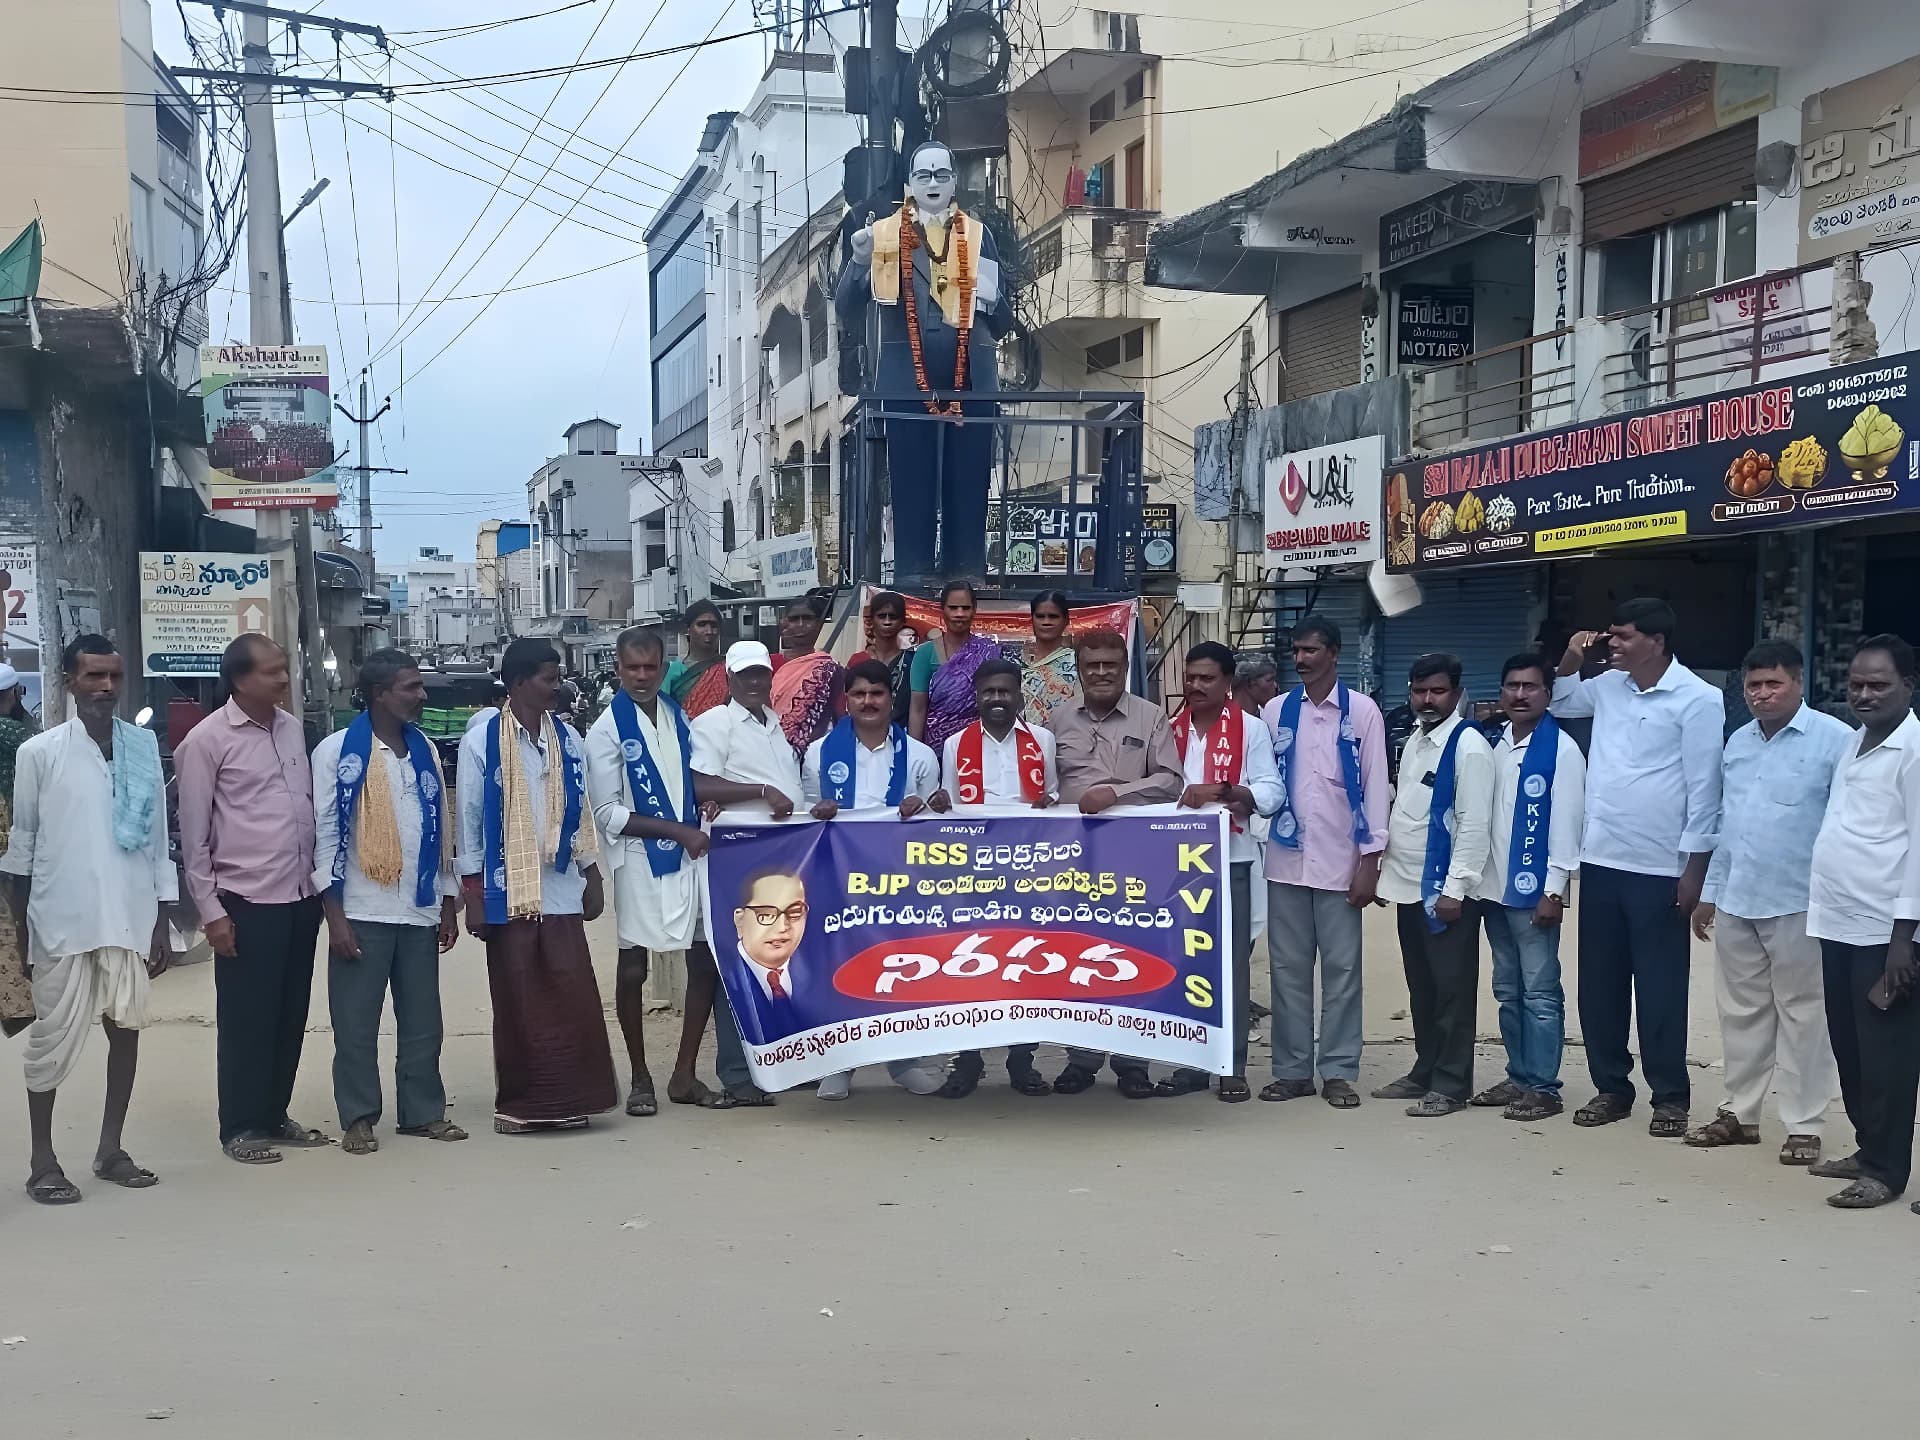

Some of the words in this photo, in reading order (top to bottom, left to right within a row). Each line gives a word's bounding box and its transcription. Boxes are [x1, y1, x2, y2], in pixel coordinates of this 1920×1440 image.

[1401, 340, 1470, 357] NOTARY
[1625, 404, 1703, 458] SWEET
[1707, 386, 1795, 442] HOUSE
[906, 841, 968, 866] RSS
[847, 872, 910, 896] BJP
[874, 933, 1140, 994] నిరసన
